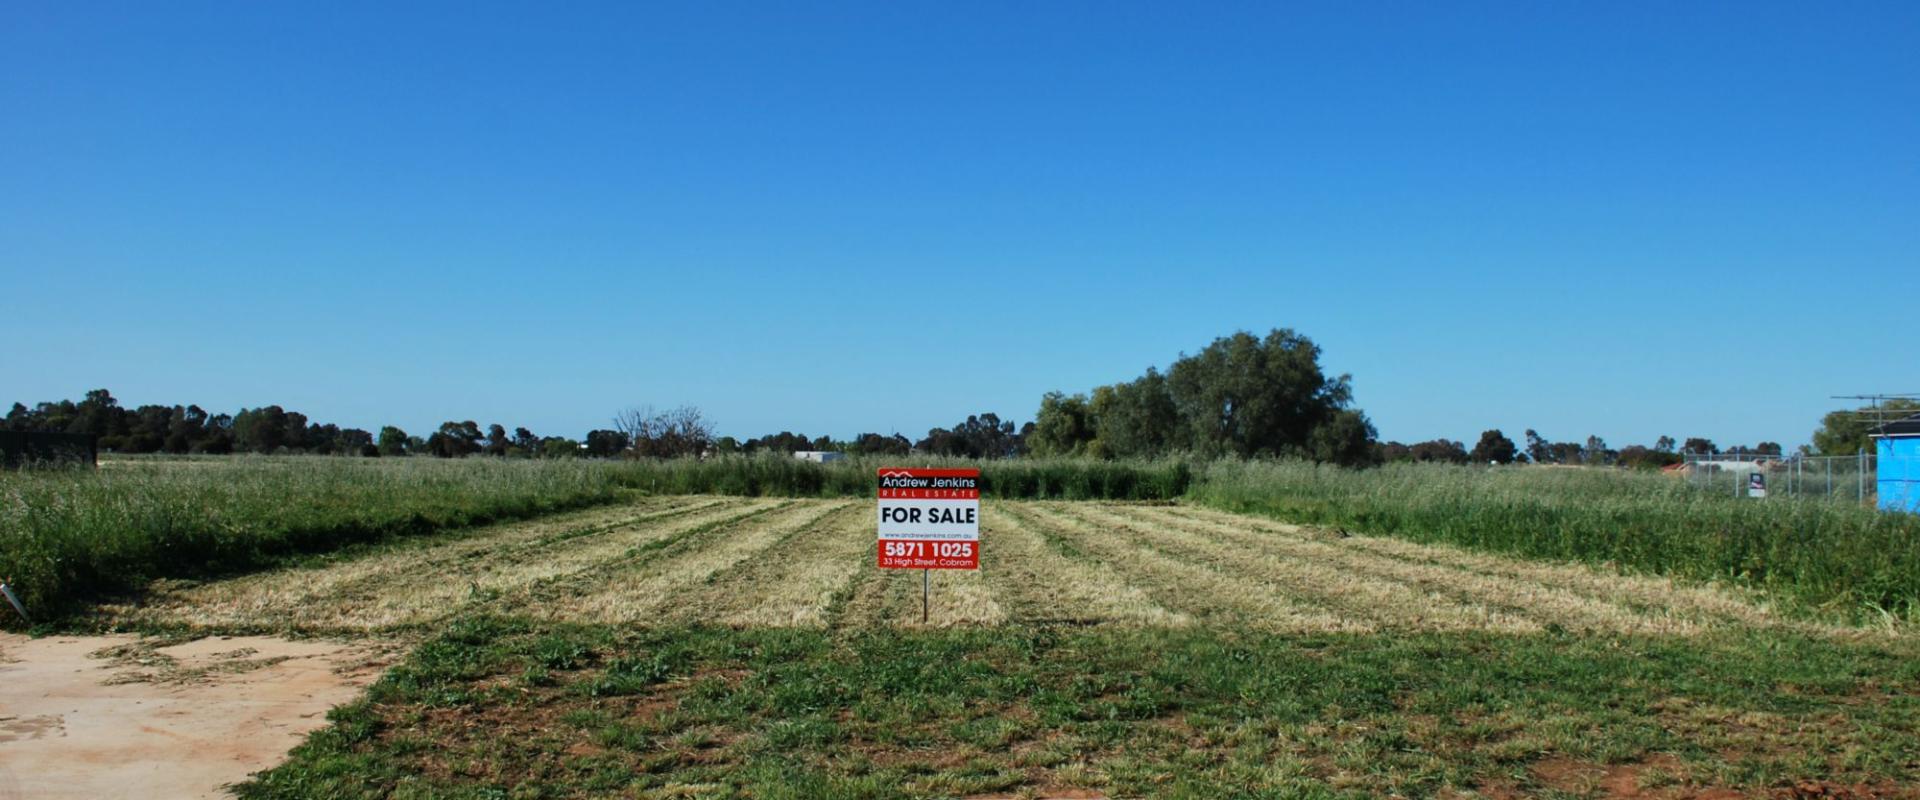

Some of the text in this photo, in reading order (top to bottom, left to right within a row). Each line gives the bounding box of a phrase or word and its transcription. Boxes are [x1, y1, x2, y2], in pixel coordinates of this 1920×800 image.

[882, 477, 975, 488] Andrew Jenkins
[882, 507, 975, 524] FOR SALE
[885, 542, 972, 557] 5871 1025
[894, 558, 912, 567] High
